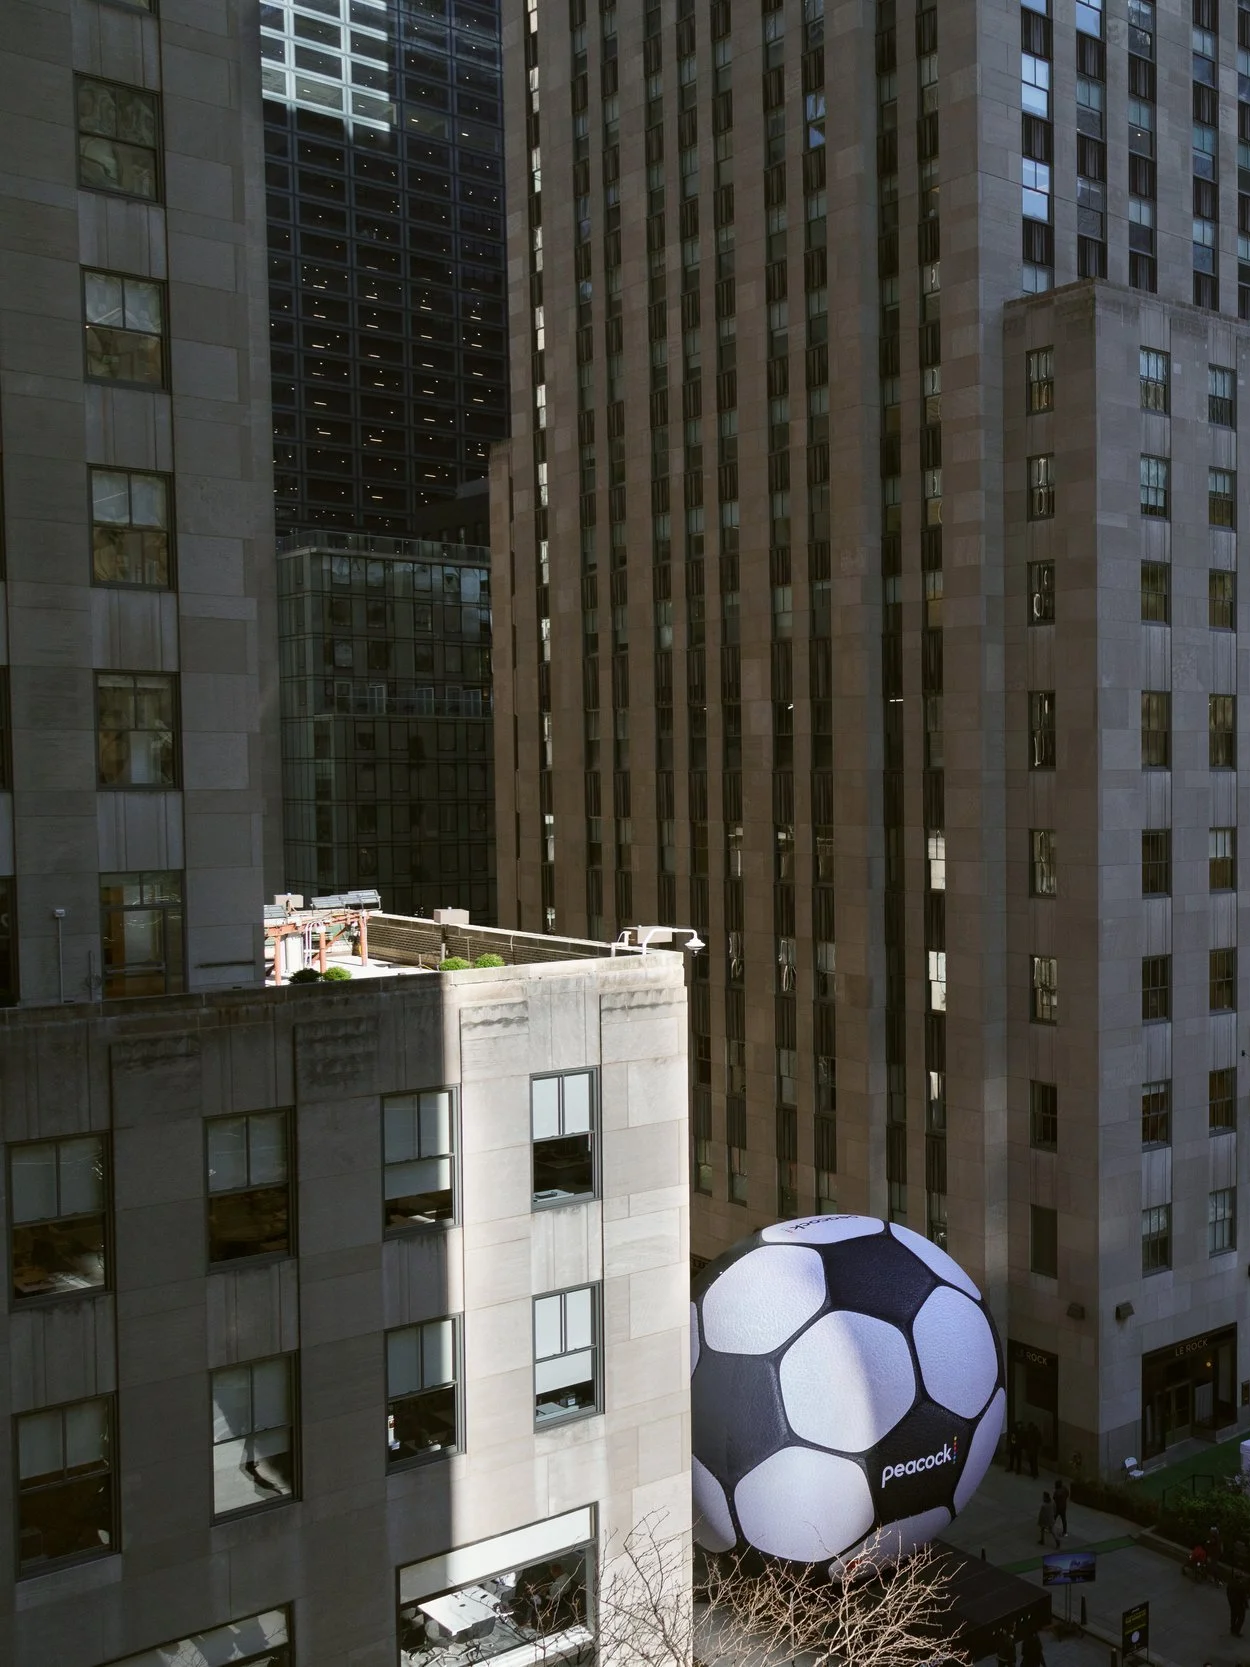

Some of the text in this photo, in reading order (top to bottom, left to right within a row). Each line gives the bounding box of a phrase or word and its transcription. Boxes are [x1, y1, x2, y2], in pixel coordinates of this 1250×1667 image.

[1175, 1338, 1208, 1357] LE ROCK
[1026, 1351, 1047, 1366] ROCK
[881, 1443, 952, 1489] peacock
